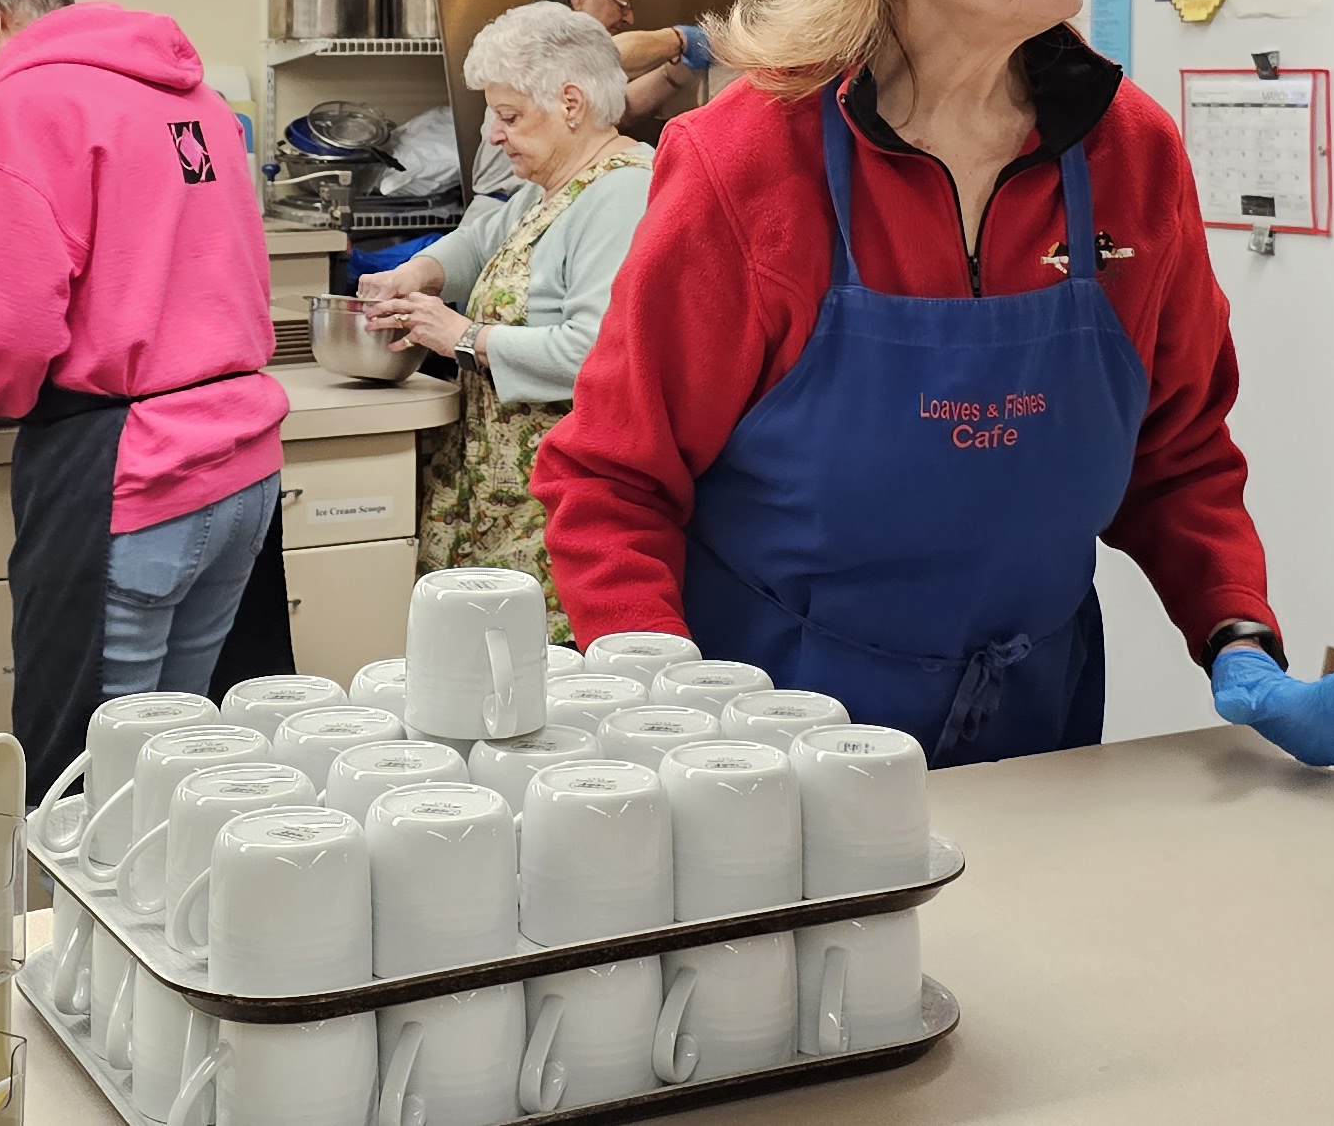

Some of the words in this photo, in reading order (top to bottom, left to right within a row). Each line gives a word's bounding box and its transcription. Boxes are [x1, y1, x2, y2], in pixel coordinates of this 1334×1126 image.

[920, 391, 981, 422] Loaves
[986, 403, 1000, 418] &
[1004, 390, 1046, 420] Fishes
[952, 423, 1018, 449] Cafe
[315, 508, 328, 517] Ice
[329, 507, 357, 516] Cream
[358, 505, 387, 514] Scoops
